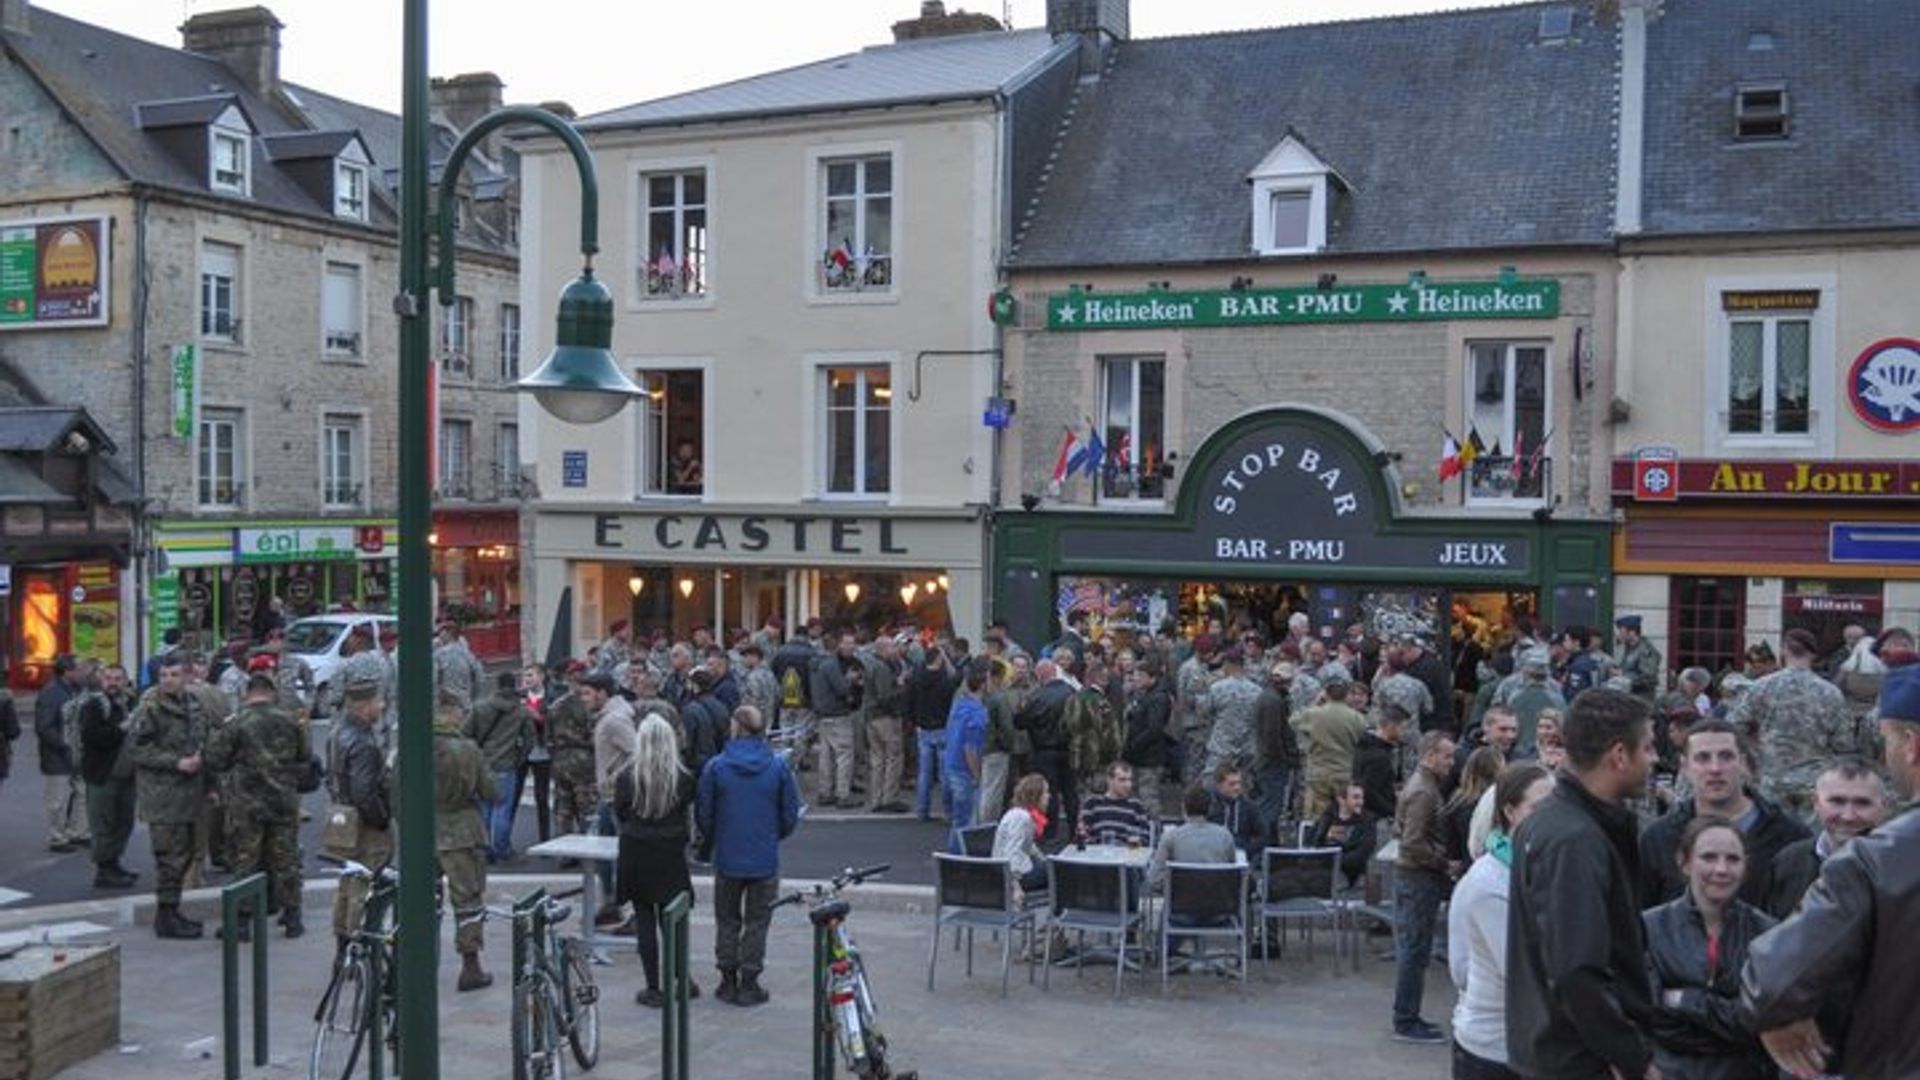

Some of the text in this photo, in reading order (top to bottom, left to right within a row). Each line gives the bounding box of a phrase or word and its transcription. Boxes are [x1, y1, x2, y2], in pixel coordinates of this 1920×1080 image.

[1084, 299, 1194, 323] Heineken
[1219, 296, 1280, 317] BAR
[1416, 287, 1543, 313] Heineken
[1213, 443, 1357, 516] STOP BAR
[1710, 461, 1766, 491] Au
[1785, 462, 1892, 492] Jour
[256, 532, 300, 553] épi
[655, 515, 908, 555] CASTEL
[1215, 537, 1267, 559] BAR
[1288, 539, 1345, 562] PMU
[1439, 543, 1507, 566] JEUX
